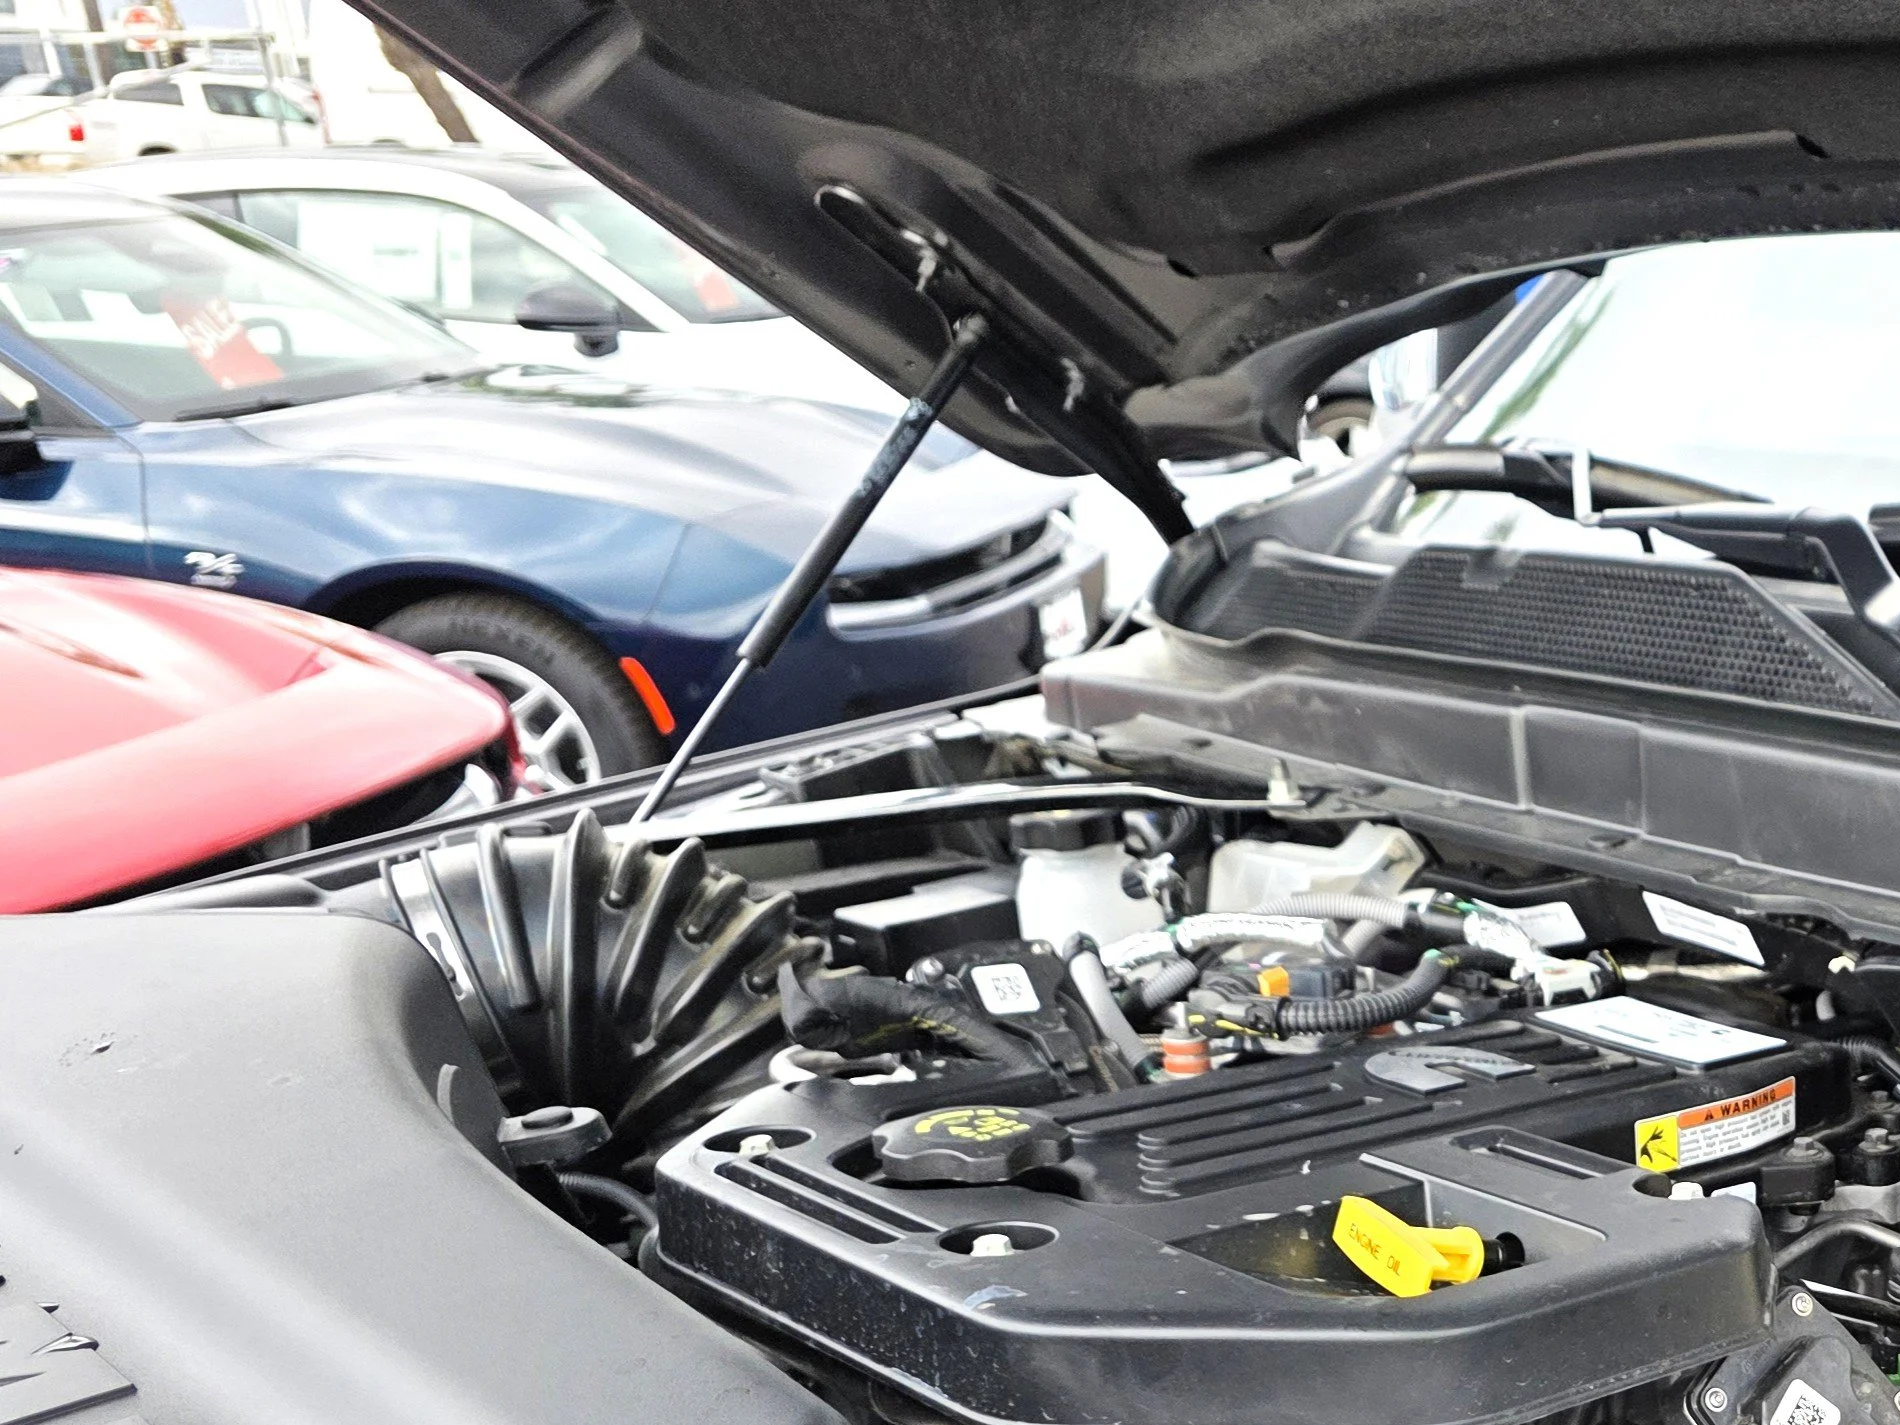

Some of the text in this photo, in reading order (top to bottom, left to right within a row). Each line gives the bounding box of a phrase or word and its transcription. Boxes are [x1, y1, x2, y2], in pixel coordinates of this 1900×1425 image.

[1721, 1089, 1777, 1116] WARNING
[1349, 1222, 1401, 1276] ENGINE OIL
